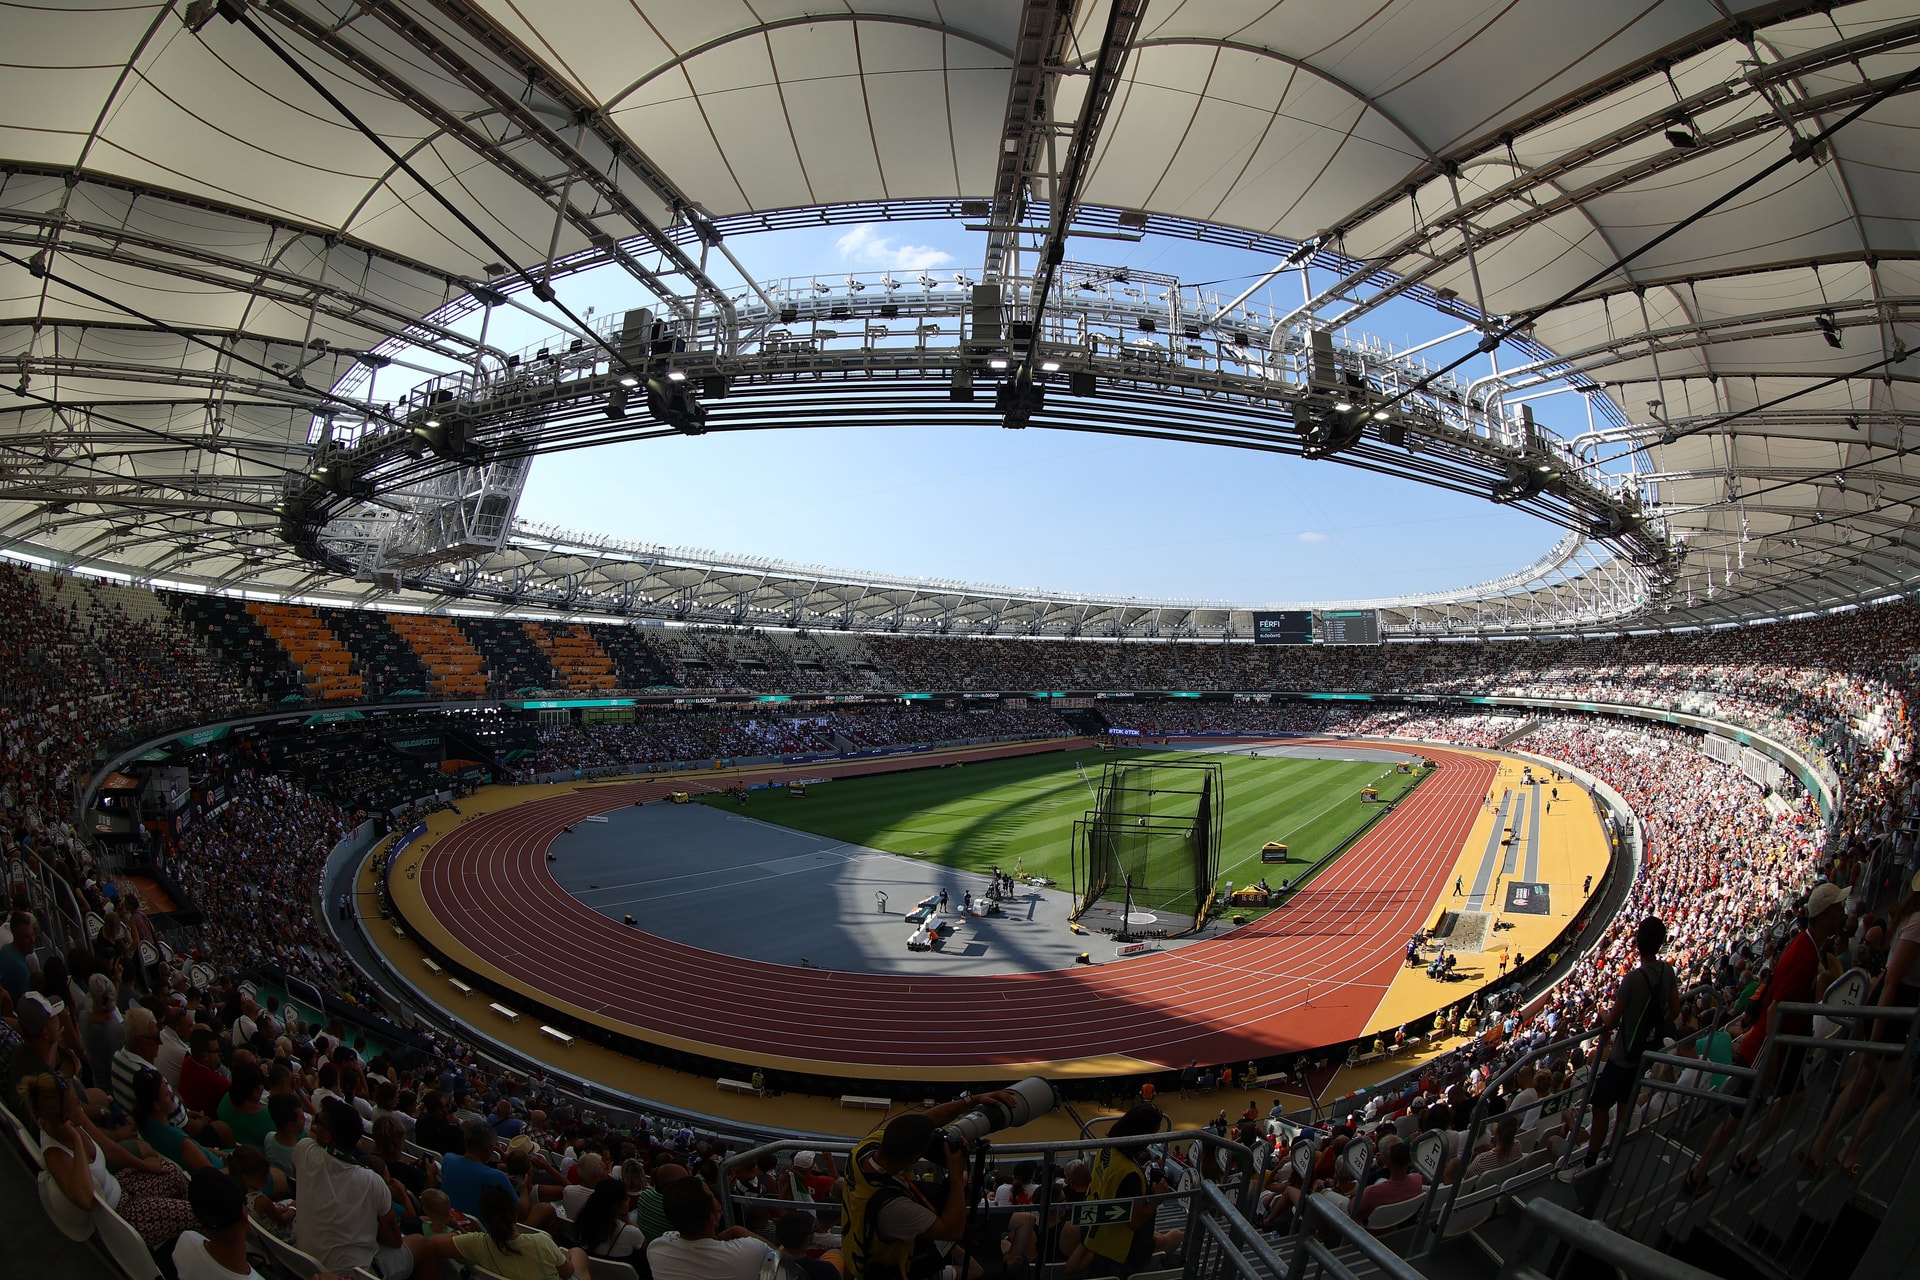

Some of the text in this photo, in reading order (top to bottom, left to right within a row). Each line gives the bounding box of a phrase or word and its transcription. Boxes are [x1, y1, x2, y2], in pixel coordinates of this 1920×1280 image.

[1260, 619, 1280, 628] FÉRFI
[1848, 982, 1860, 998] H
[1360, 1148, 1367, 1161] E
[1432, 1142, 1441, 1155] F
[1354, 1157, 1363, 1170] 231
[1424, 1154, 1436, 1169] 231
